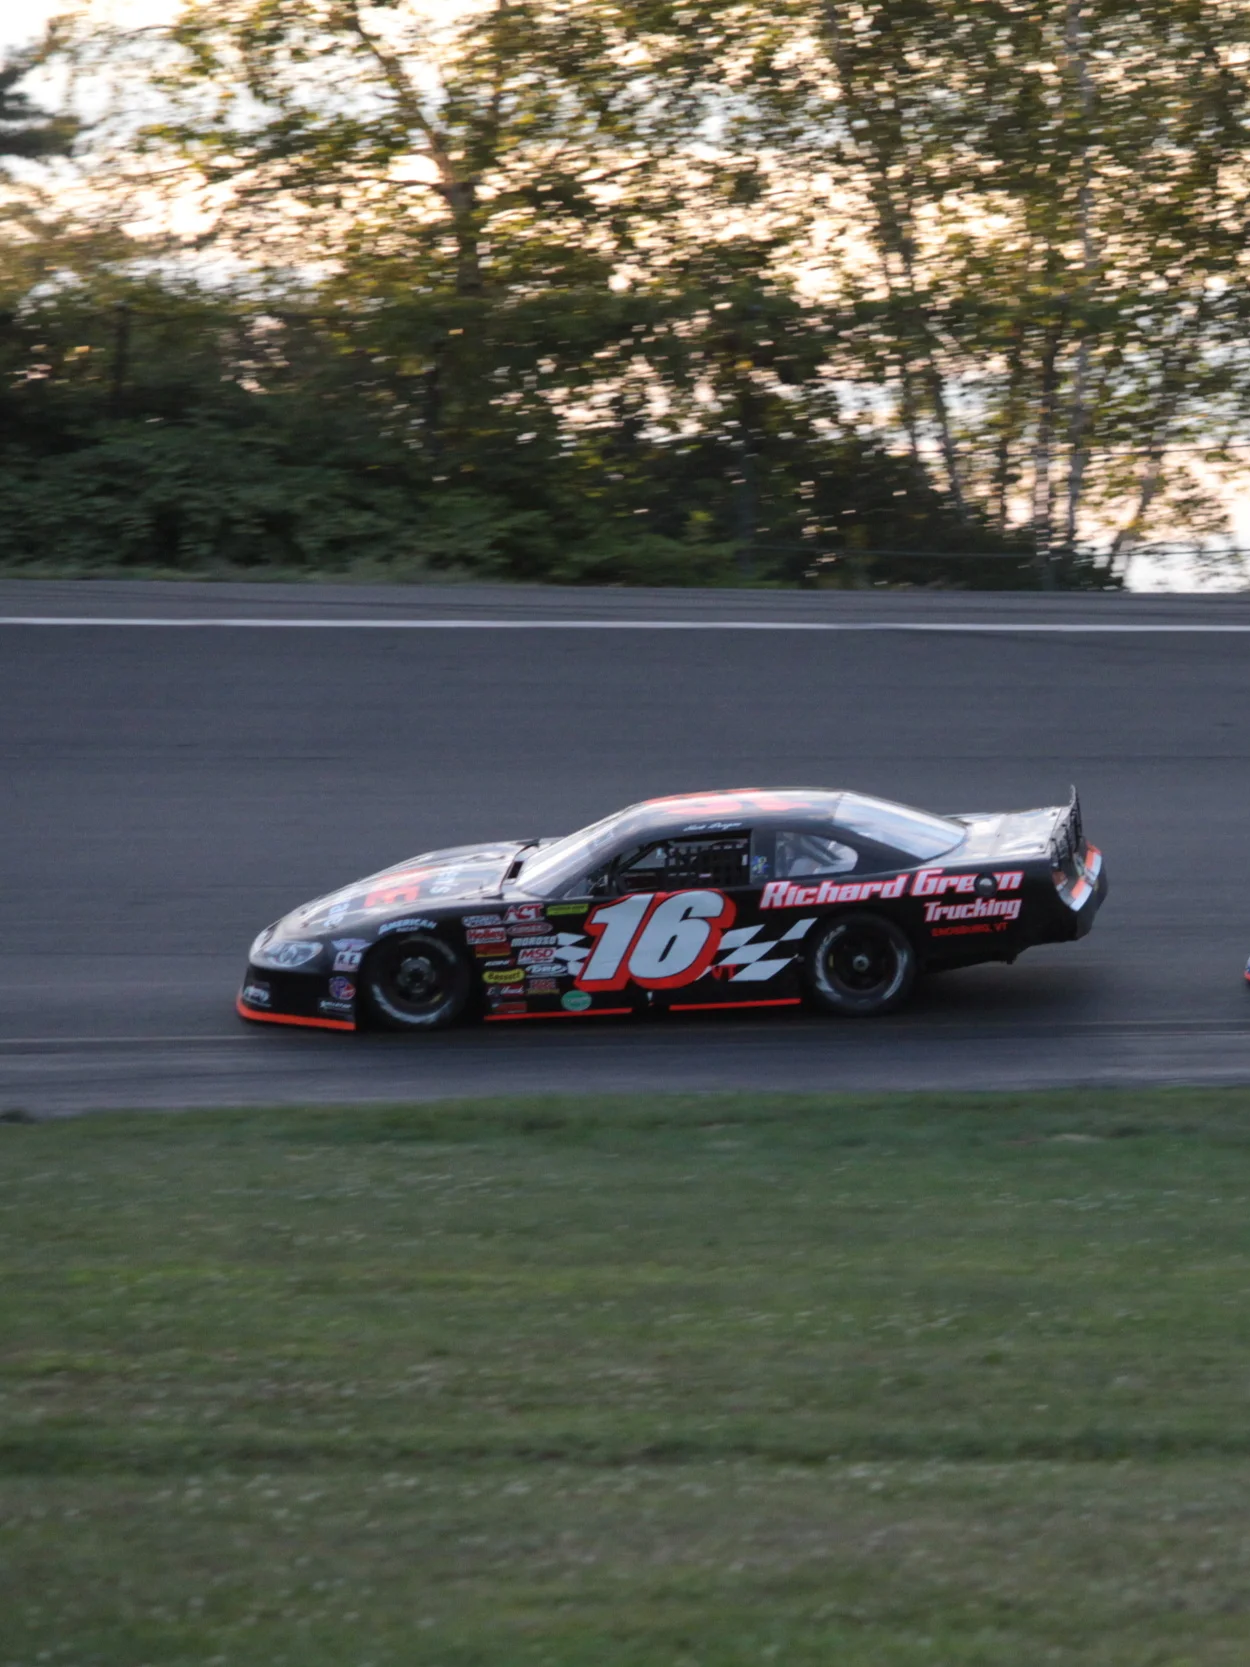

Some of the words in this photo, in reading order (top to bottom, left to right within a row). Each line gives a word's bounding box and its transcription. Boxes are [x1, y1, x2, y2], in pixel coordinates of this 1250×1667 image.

[759, 874, 909, 909] Richard
[909, 868, 1024, 897] Gren
[504, 904, 544, 923] ACT
[924, 898, 1022, 922] Trucking
[378, 918, 438, 935] AMERICAN
[574, 888, 736, 992] 16
[519, 948, 554, 960] MSD
[711, 965, 737, 980] VT
